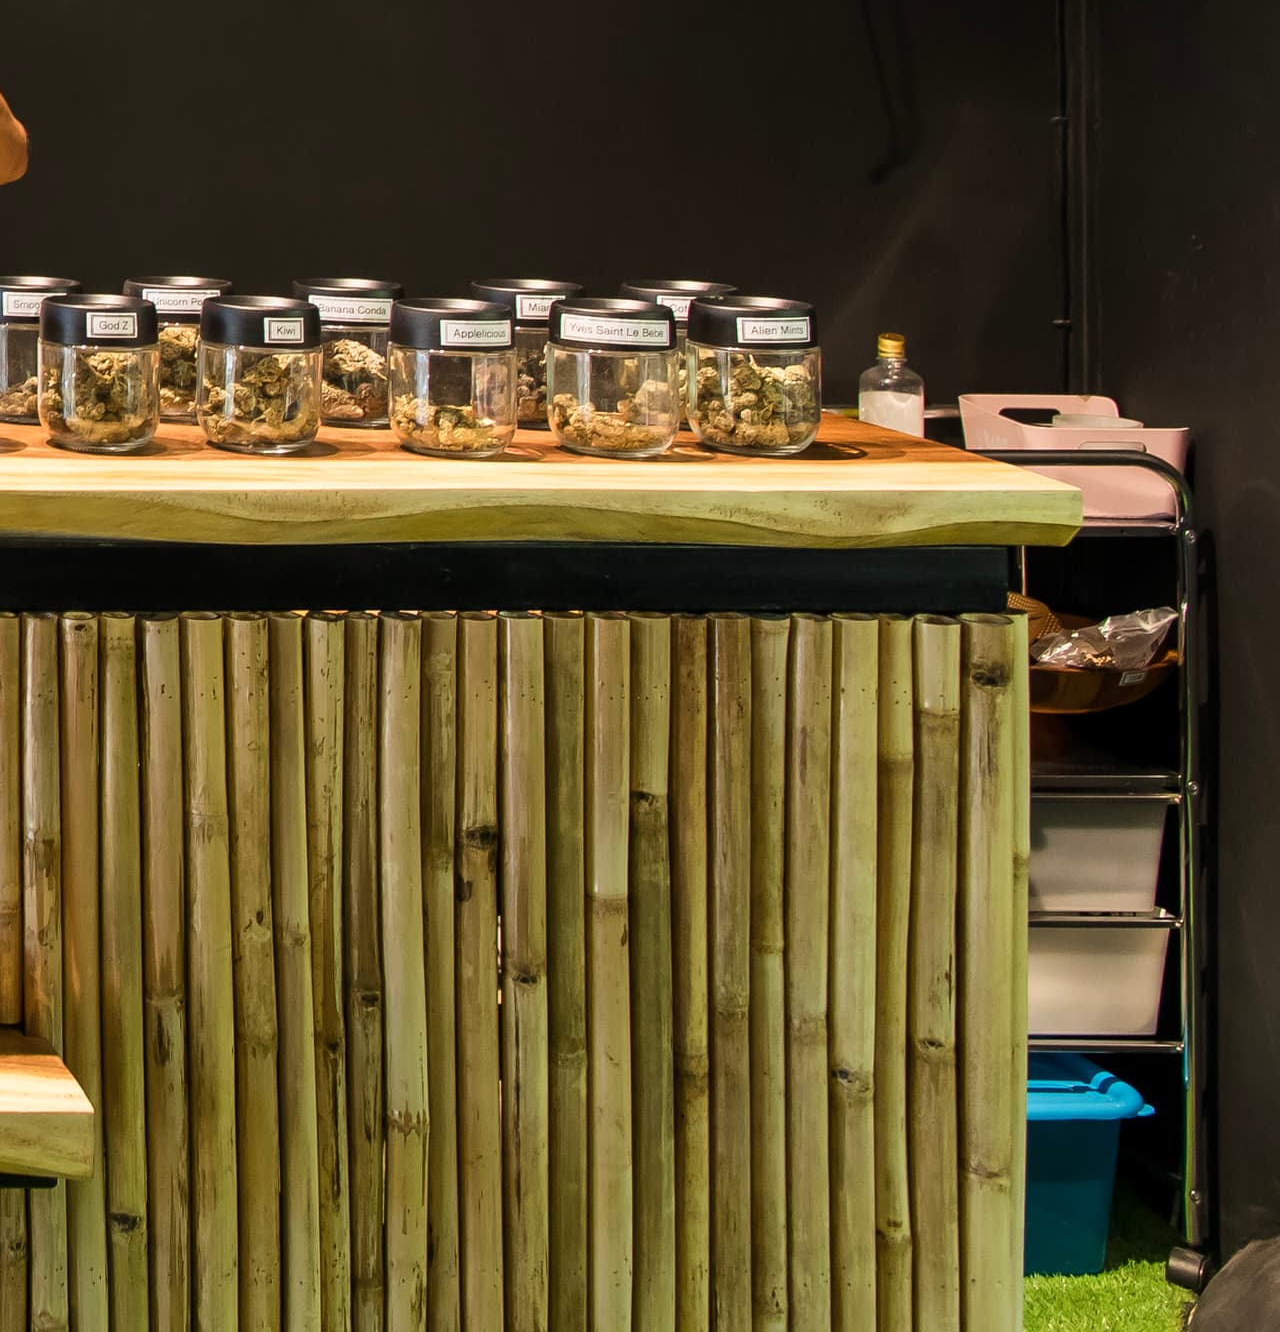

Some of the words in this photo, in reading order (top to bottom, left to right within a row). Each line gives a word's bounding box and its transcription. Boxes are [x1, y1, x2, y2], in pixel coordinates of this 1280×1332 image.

[357, 305, 387, 316] Conda
[98, 320, 120, 331] God
[121, 321, 129, 331] Z
[276, 325, 296, 336] Kiwi
[596, 323, 623, 337] Saint
[626, 326, 639, 338] Le
[751, 324, 778, 336] Alien
[454, 328, 506, 340] Applelicious
